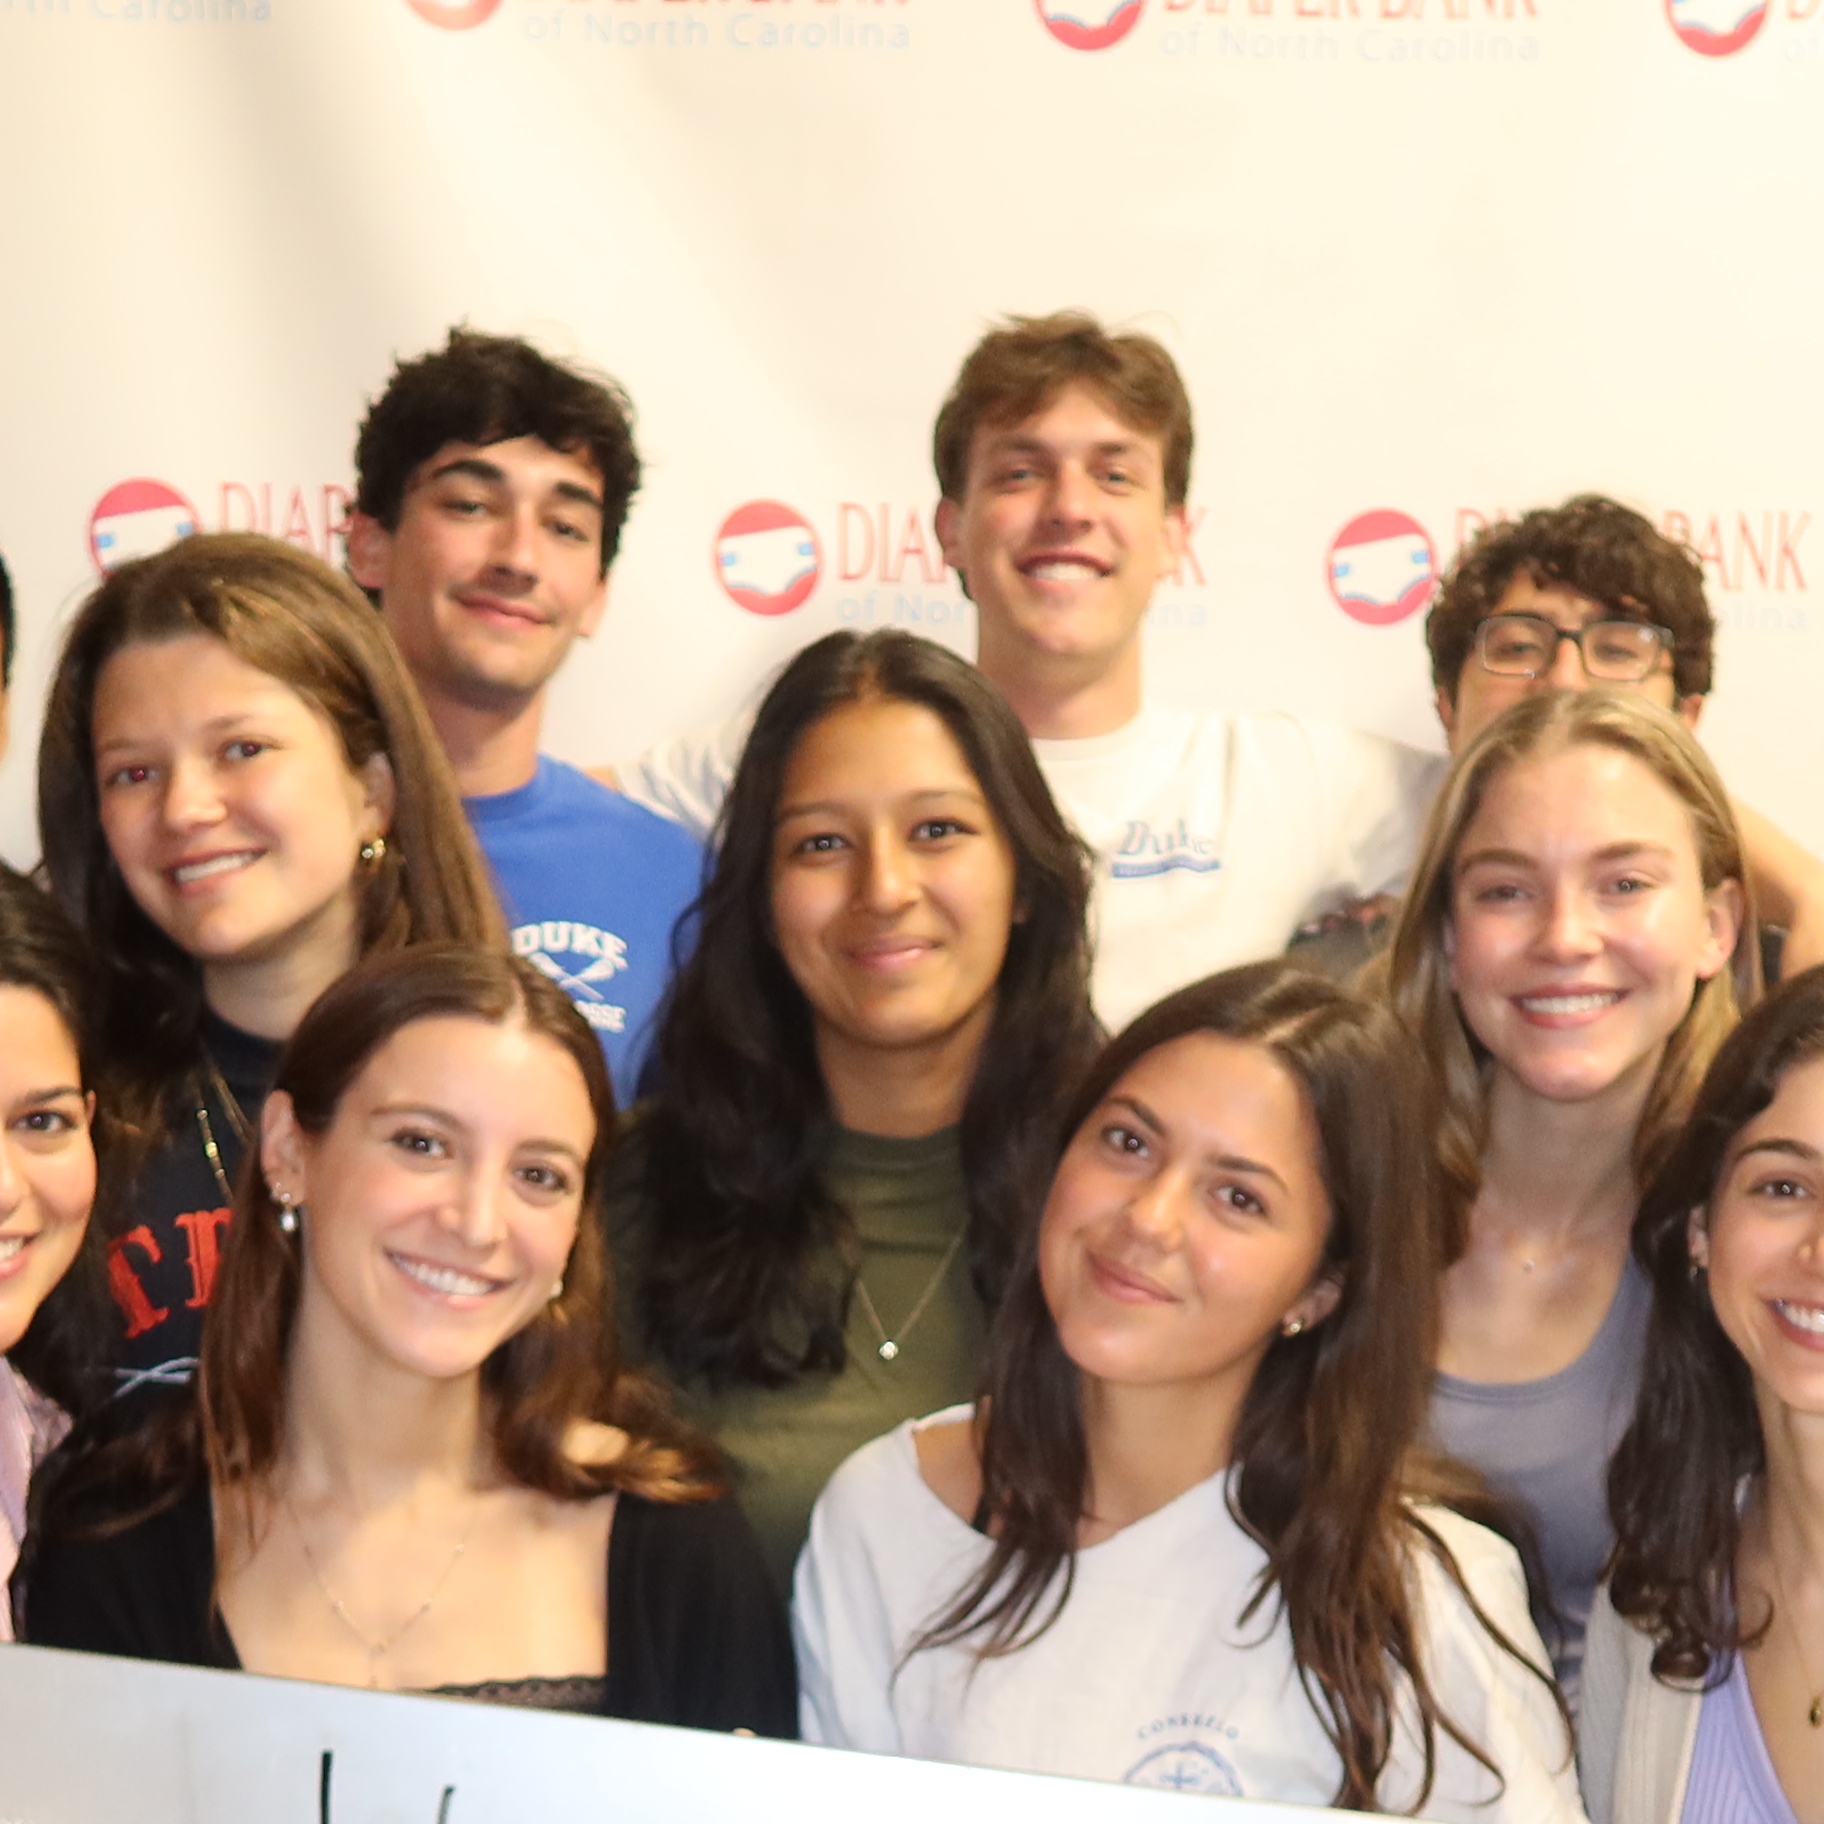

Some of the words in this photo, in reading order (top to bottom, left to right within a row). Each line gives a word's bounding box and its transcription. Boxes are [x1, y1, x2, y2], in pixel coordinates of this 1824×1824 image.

[524, 9, 564, 41] of
[585, 12, 709, 47] North
[729, 13, 911, 48] Carolina
[1216, 25, 1339, 60] North
[1356, 28, 1540, 63] Carolina
[218, 479, 355, 567] DIAP
[511, 920, 629, 972] DUKE
